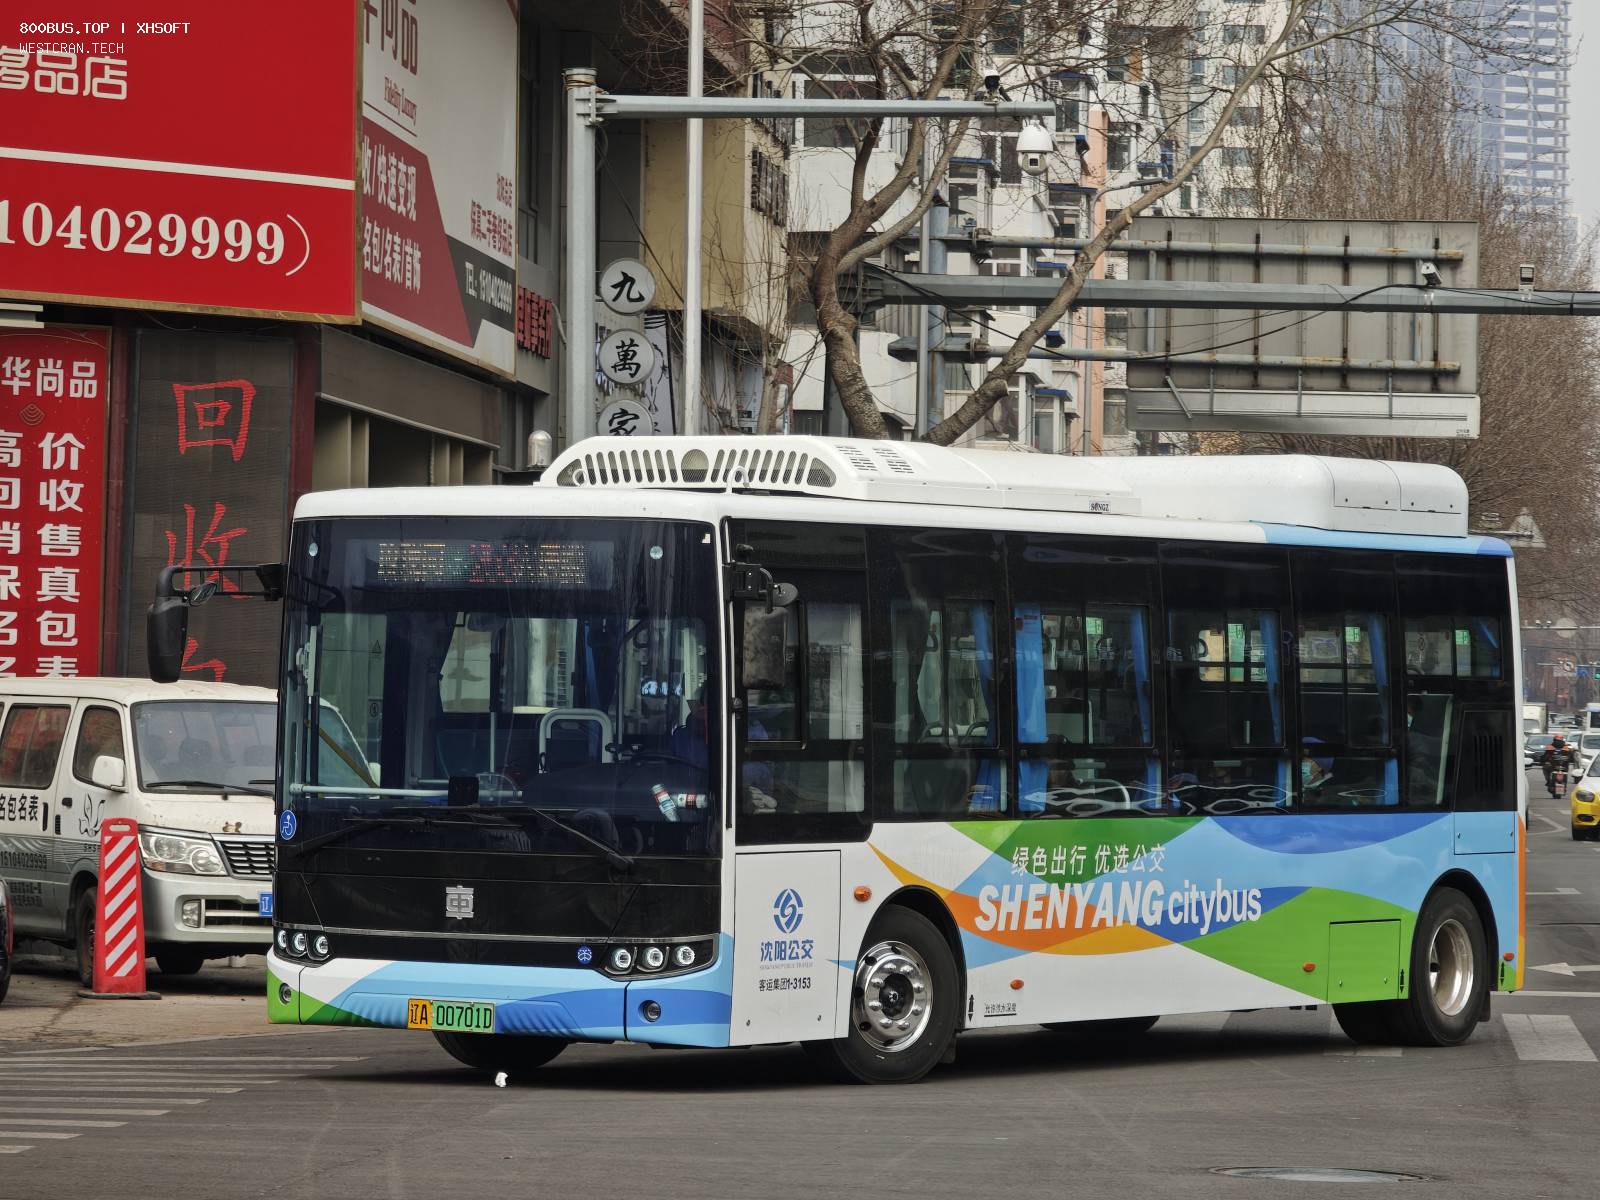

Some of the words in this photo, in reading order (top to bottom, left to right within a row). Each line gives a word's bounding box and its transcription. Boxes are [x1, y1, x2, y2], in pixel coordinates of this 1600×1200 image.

[1, 356, 98, 399] 华尚品
[1011, 845, 1087, 876] 绿色出行
[1094, 843, 1167, 874] 优选公交
[974, 880, 1166, 931] SHENYANG
[1167, 879, 1262, 936] citybus
[760, 939, 815, 962] 沈阳公交
